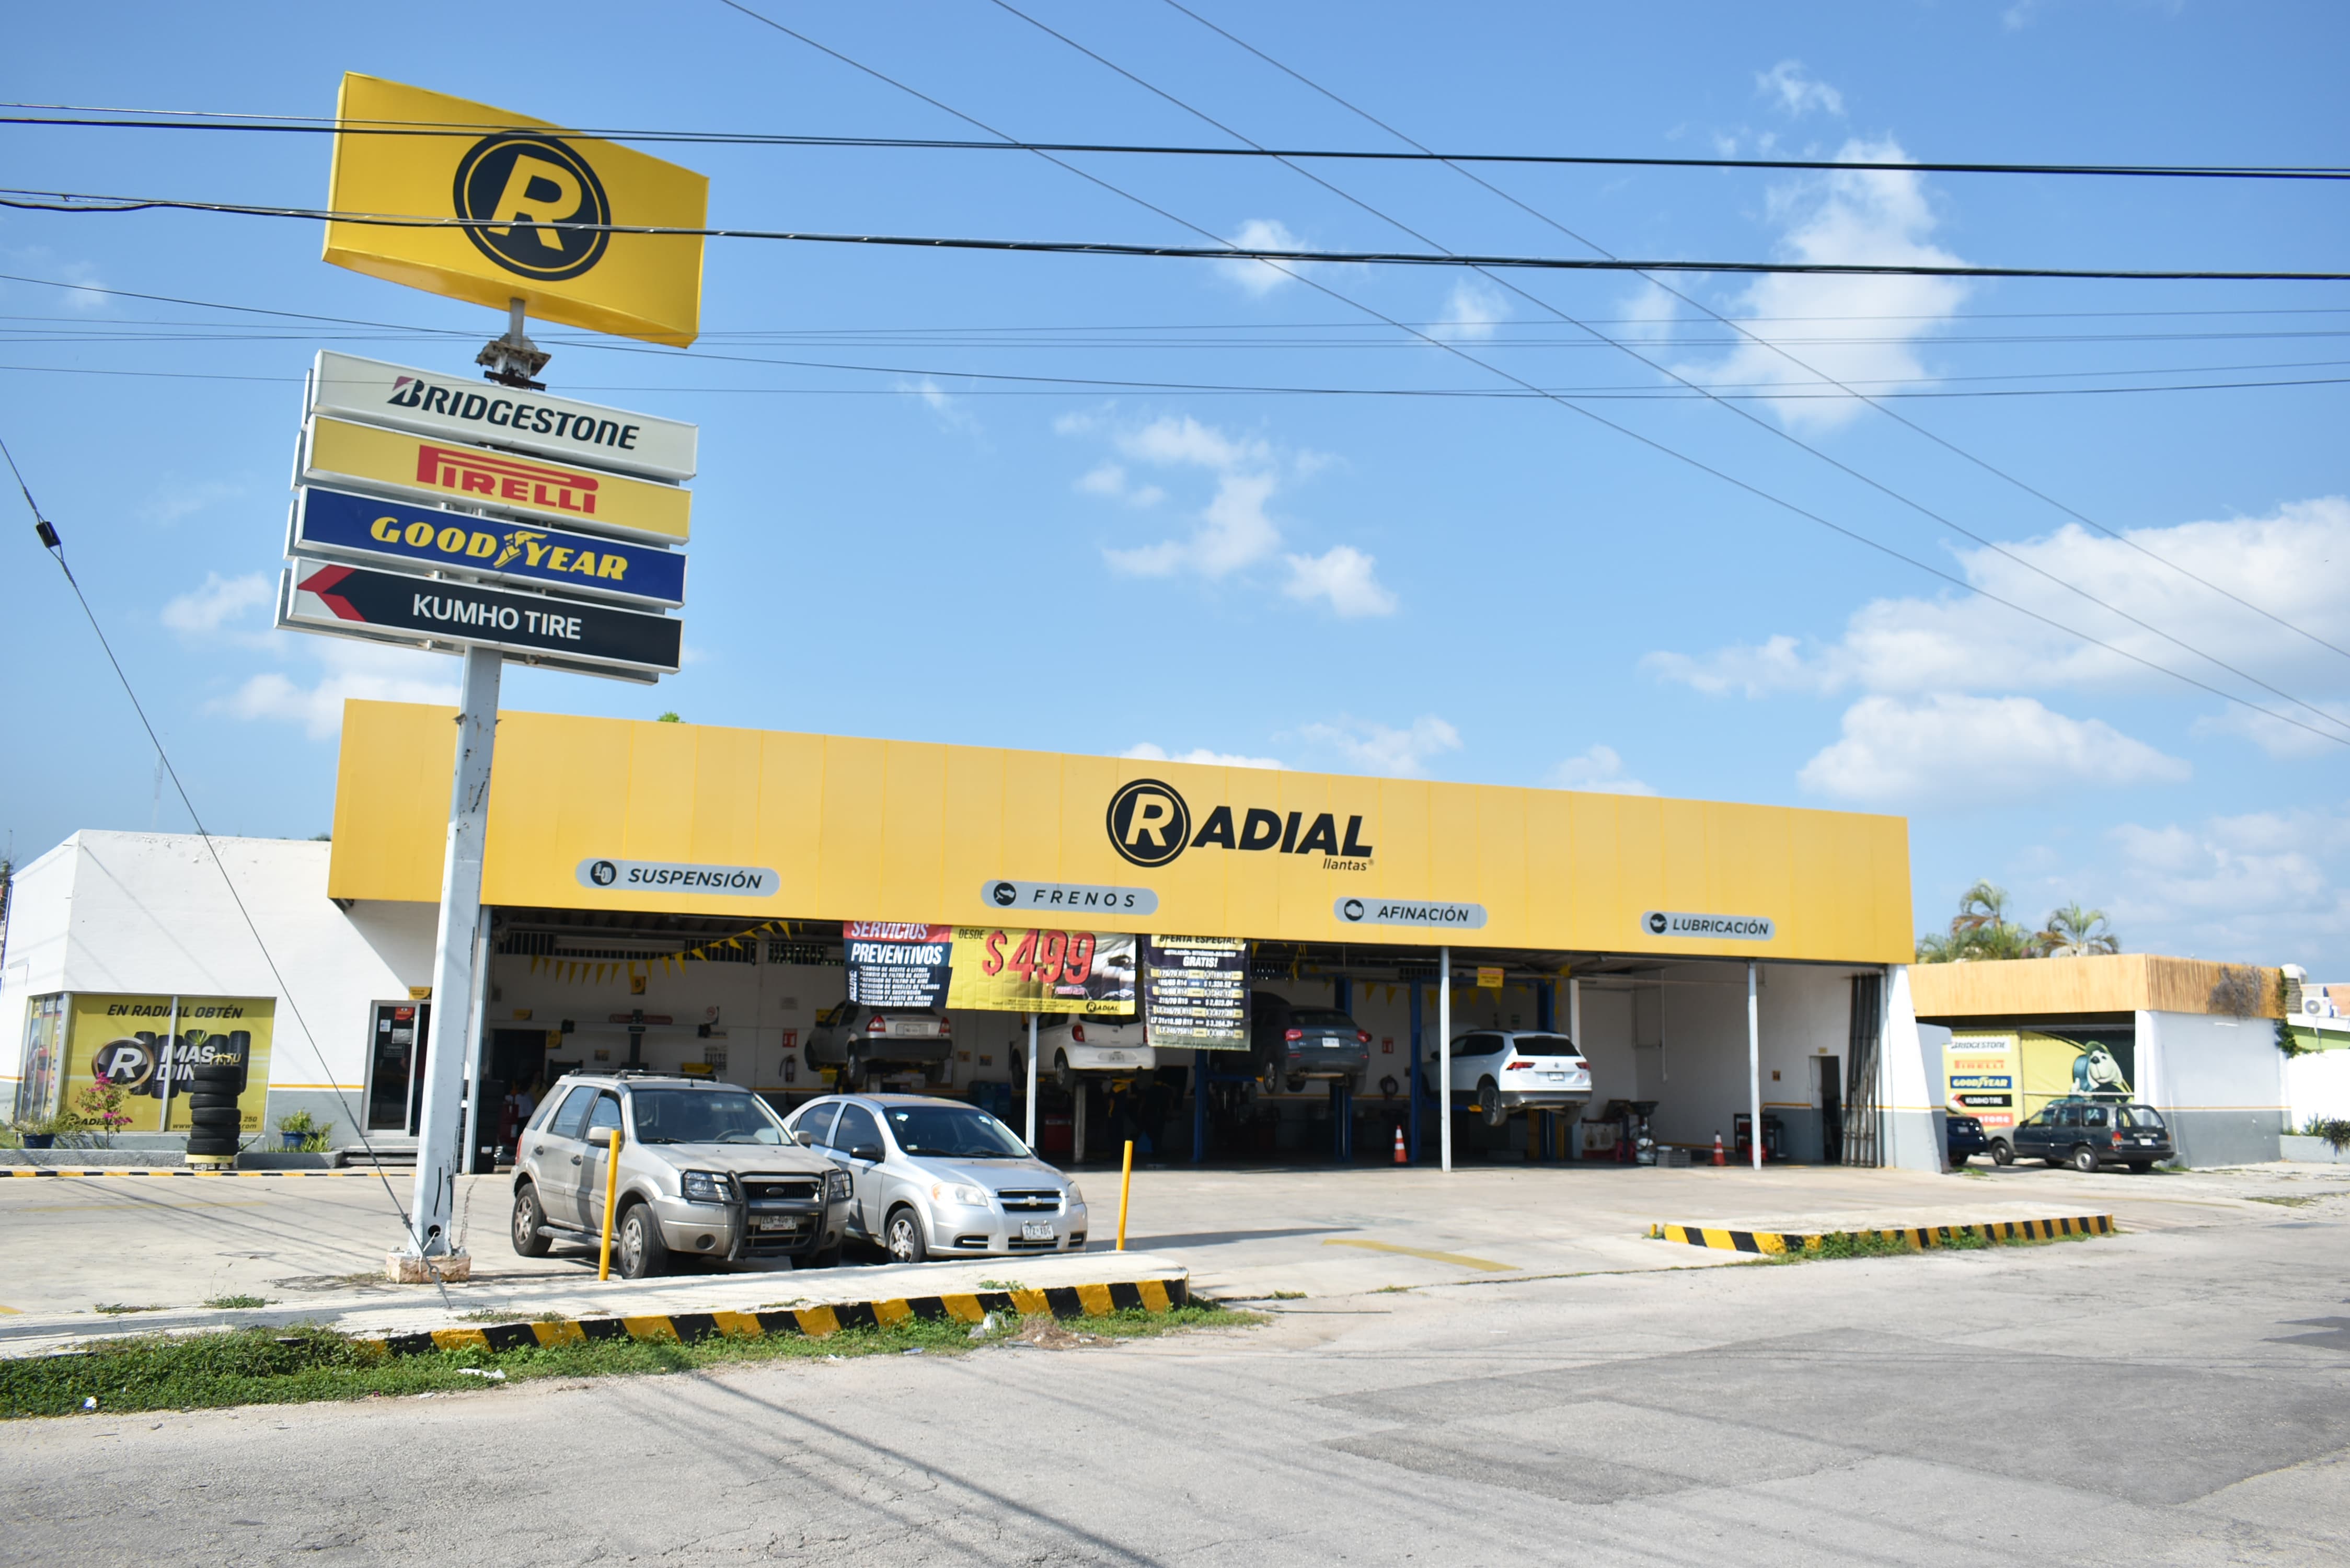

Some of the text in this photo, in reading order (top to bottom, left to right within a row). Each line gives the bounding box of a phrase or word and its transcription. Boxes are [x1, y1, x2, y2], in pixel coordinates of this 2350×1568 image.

[387, 375, 640, 451] BRIDGESTONE
[416, 444, 599, 514] PIRELLI
[412, 593, 582, 640] KUMHO TIRE
[628, 868, 762, 890] SUSPENSIÓN
[1033, 889, 1135, 908] FRENOS
[1377, 905, 1469, 922] AFINACIÓN
[958, 928, 985, 940] DESDE
[1673, 918, 1769, 935] LUBRICACIÓN
[850, 942, 943, 965] PREVENTIVOS
[1183, 956, 1218, 967] GRATIS!
[107, 1004, 129, 1016] EN
[194, 1005, 244, 1019] OBTÉN
[107, 1047, 143, 1078] R
[1954, 1059, 2004, 1069] PIRELLI
[1978, 1115, 2010, 1124] stone
